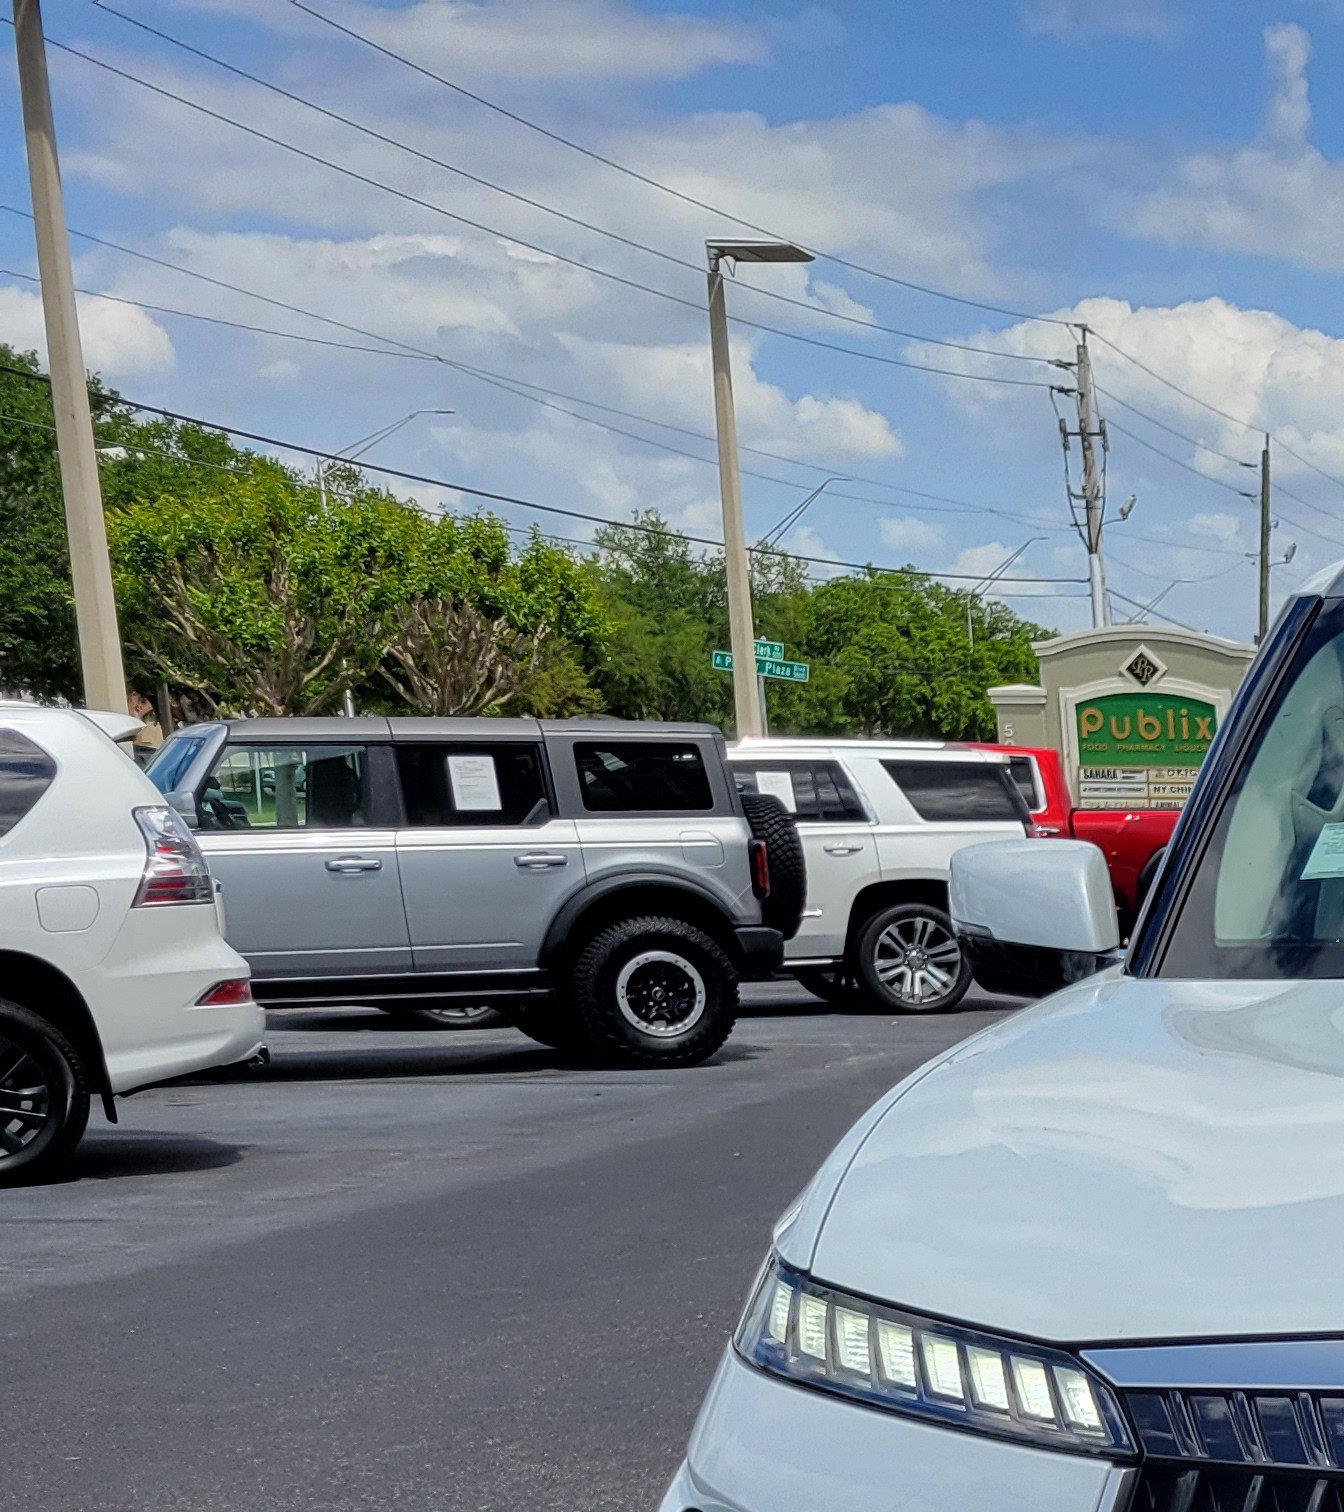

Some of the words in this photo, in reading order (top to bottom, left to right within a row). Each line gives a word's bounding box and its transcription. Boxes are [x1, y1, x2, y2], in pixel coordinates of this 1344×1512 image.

[765, 662, 791, 676] Plaza
[1080, 708, 1212, 740] Publix
[1082, 743, 1108, 752] FOOD
[1117, 743, 1165, 753] PHARMACY
[1083, 768, 1118, 780] SAHARA
